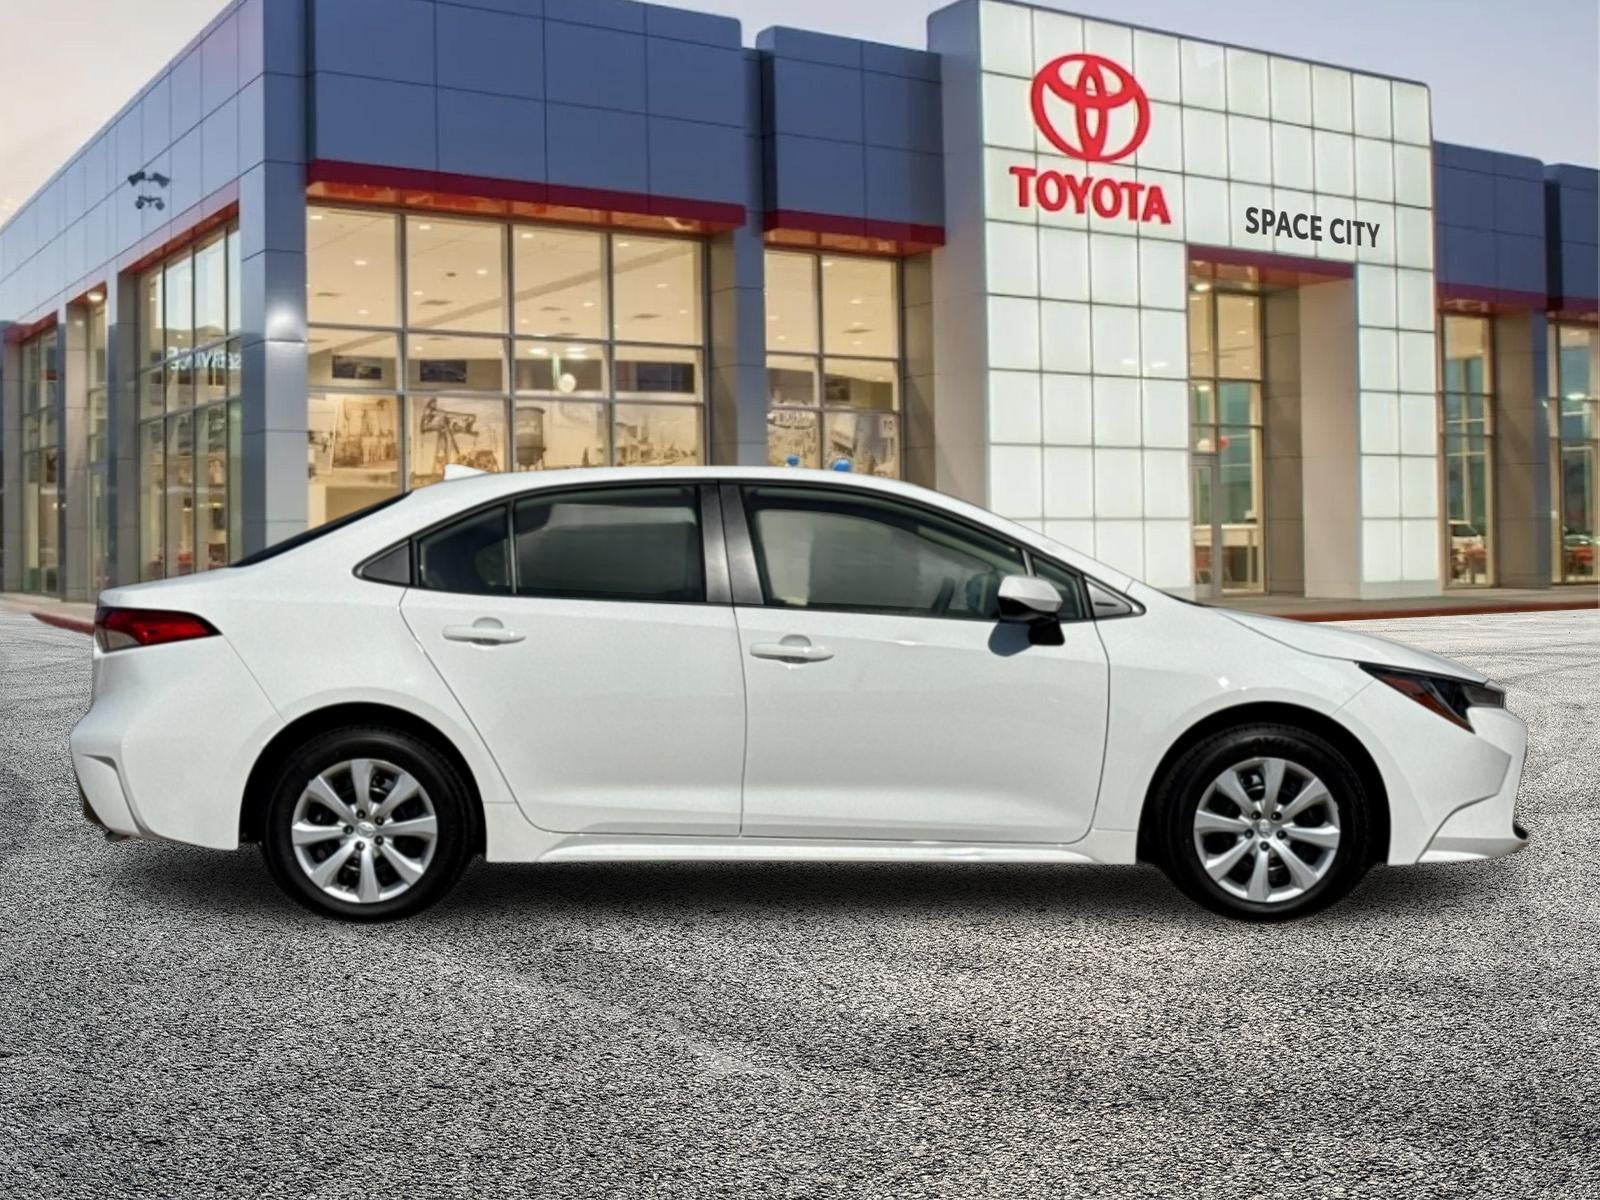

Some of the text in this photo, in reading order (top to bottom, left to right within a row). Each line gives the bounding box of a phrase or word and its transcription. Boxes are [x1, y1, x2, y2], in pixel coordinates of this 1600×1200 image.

[1009, 166, 1171, 224] TOYOTA
[1245, 206, 1380, 248] SPACE CITY
